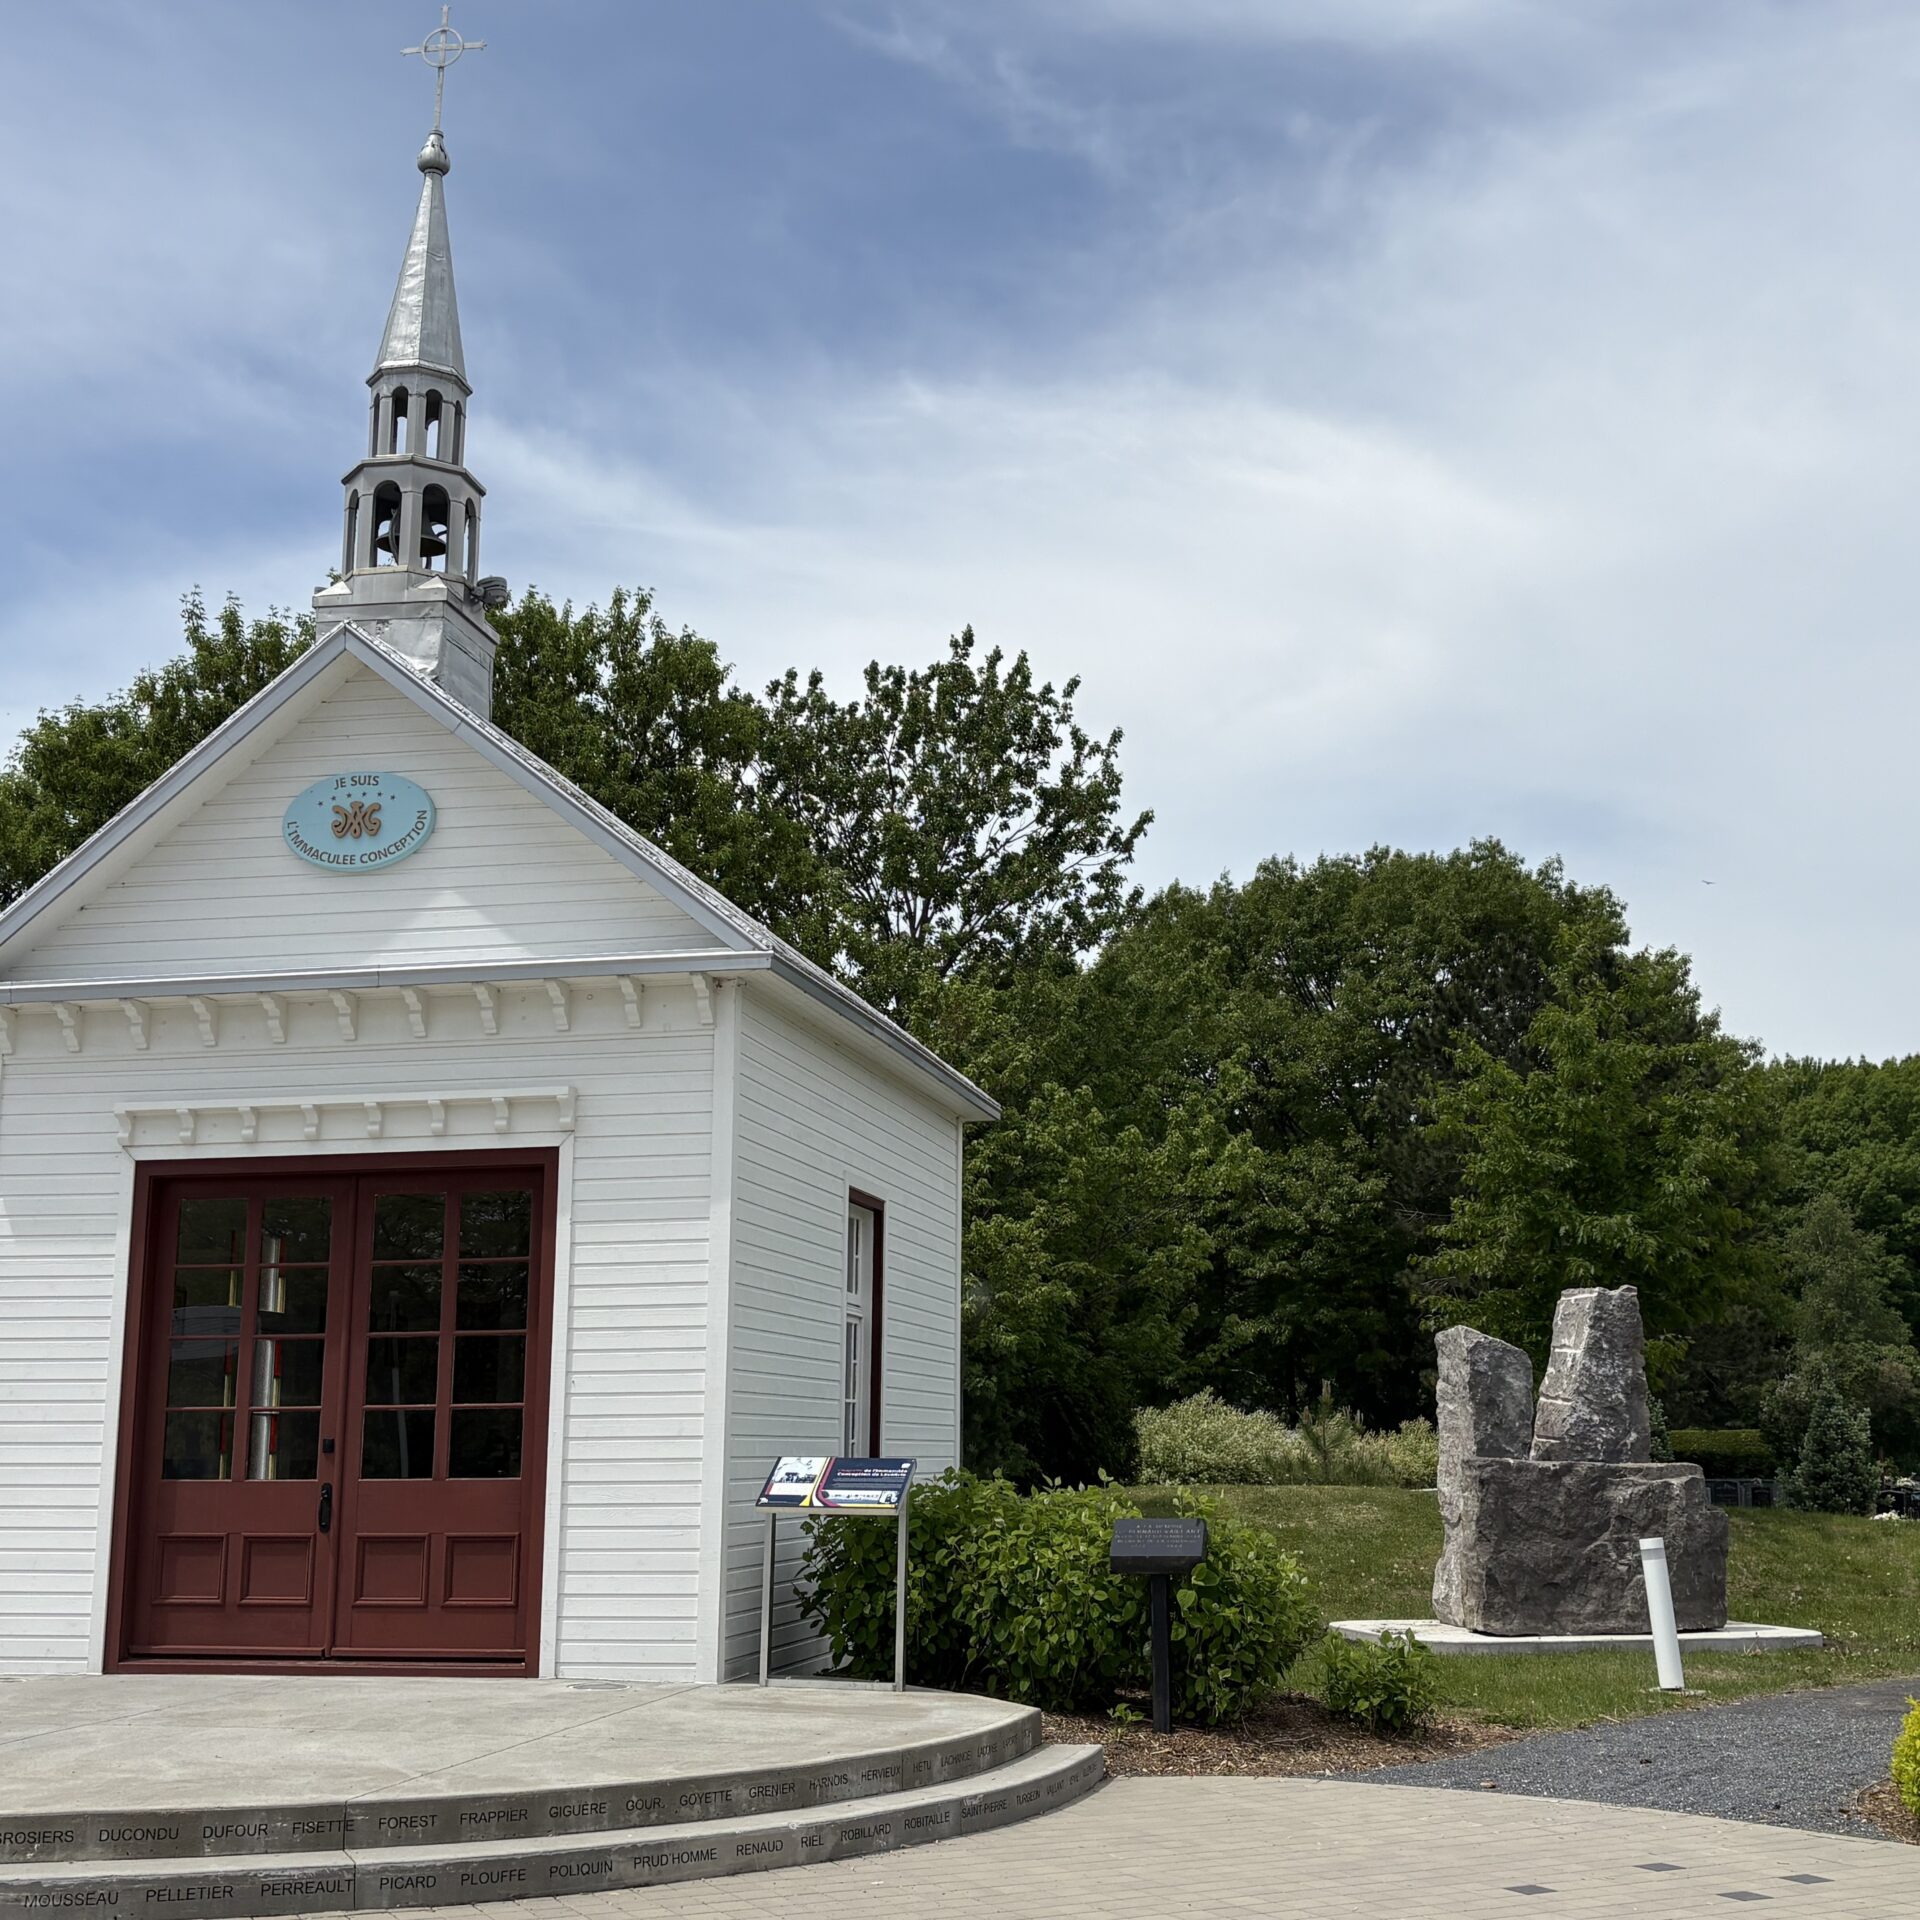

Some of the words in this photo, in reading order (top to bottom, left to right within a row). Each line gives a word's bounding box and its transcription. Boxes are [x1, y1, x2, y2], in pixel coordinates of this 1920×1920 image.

[334, 777, 347, 790] JE
[350, 775, 379, 787] SUIS
[287, 821, 356, 865] L'IMMACULEE
[360, 810, 427, 864] CONCEPTION
[0, 1831, 74, 1845] ROSIERS
[99, 1828, 179, 1842] DUCONDU
[203, 1823, 268, 1838] DUFOUR
[293, 1819, 355, 1834] FISETTE
[378, 1814, 438, 1830] FOREST
[460, 1808, 528, 1825] FRAPPIER
[679, 1789, 732, 1807] GOYETTE
[749, 1783, 795, 1798] GRENIER
[809, 1773, 848, 1790] HARNOIS
[861, 1766, 900, 1782] HERVIEUX
[24, 1891, 119, 1908] MOUSSEAU
[146, 1885, 234, 1902] PELLETIER
[261, 1878, 354, 1897] PERREAULT
[379, 1875, 437, 1890] PICARD
[460, 1868, 527, 1886] PLOUFFE
[550, 1860, 613, 1878] POLIQUIN
[634, 1848, 718, 1869] PRUD'HOMME
[736, 1839, 784, 1856] RENAUD
[801, 1834, 824, 1848] RIEL
[840, 1823, 891, 1842] ROBILLARD
[904, 1811, 950, 1830] ROBITAILLE
[961, 1800, 1008, 1819] SAINT-PIERRE
